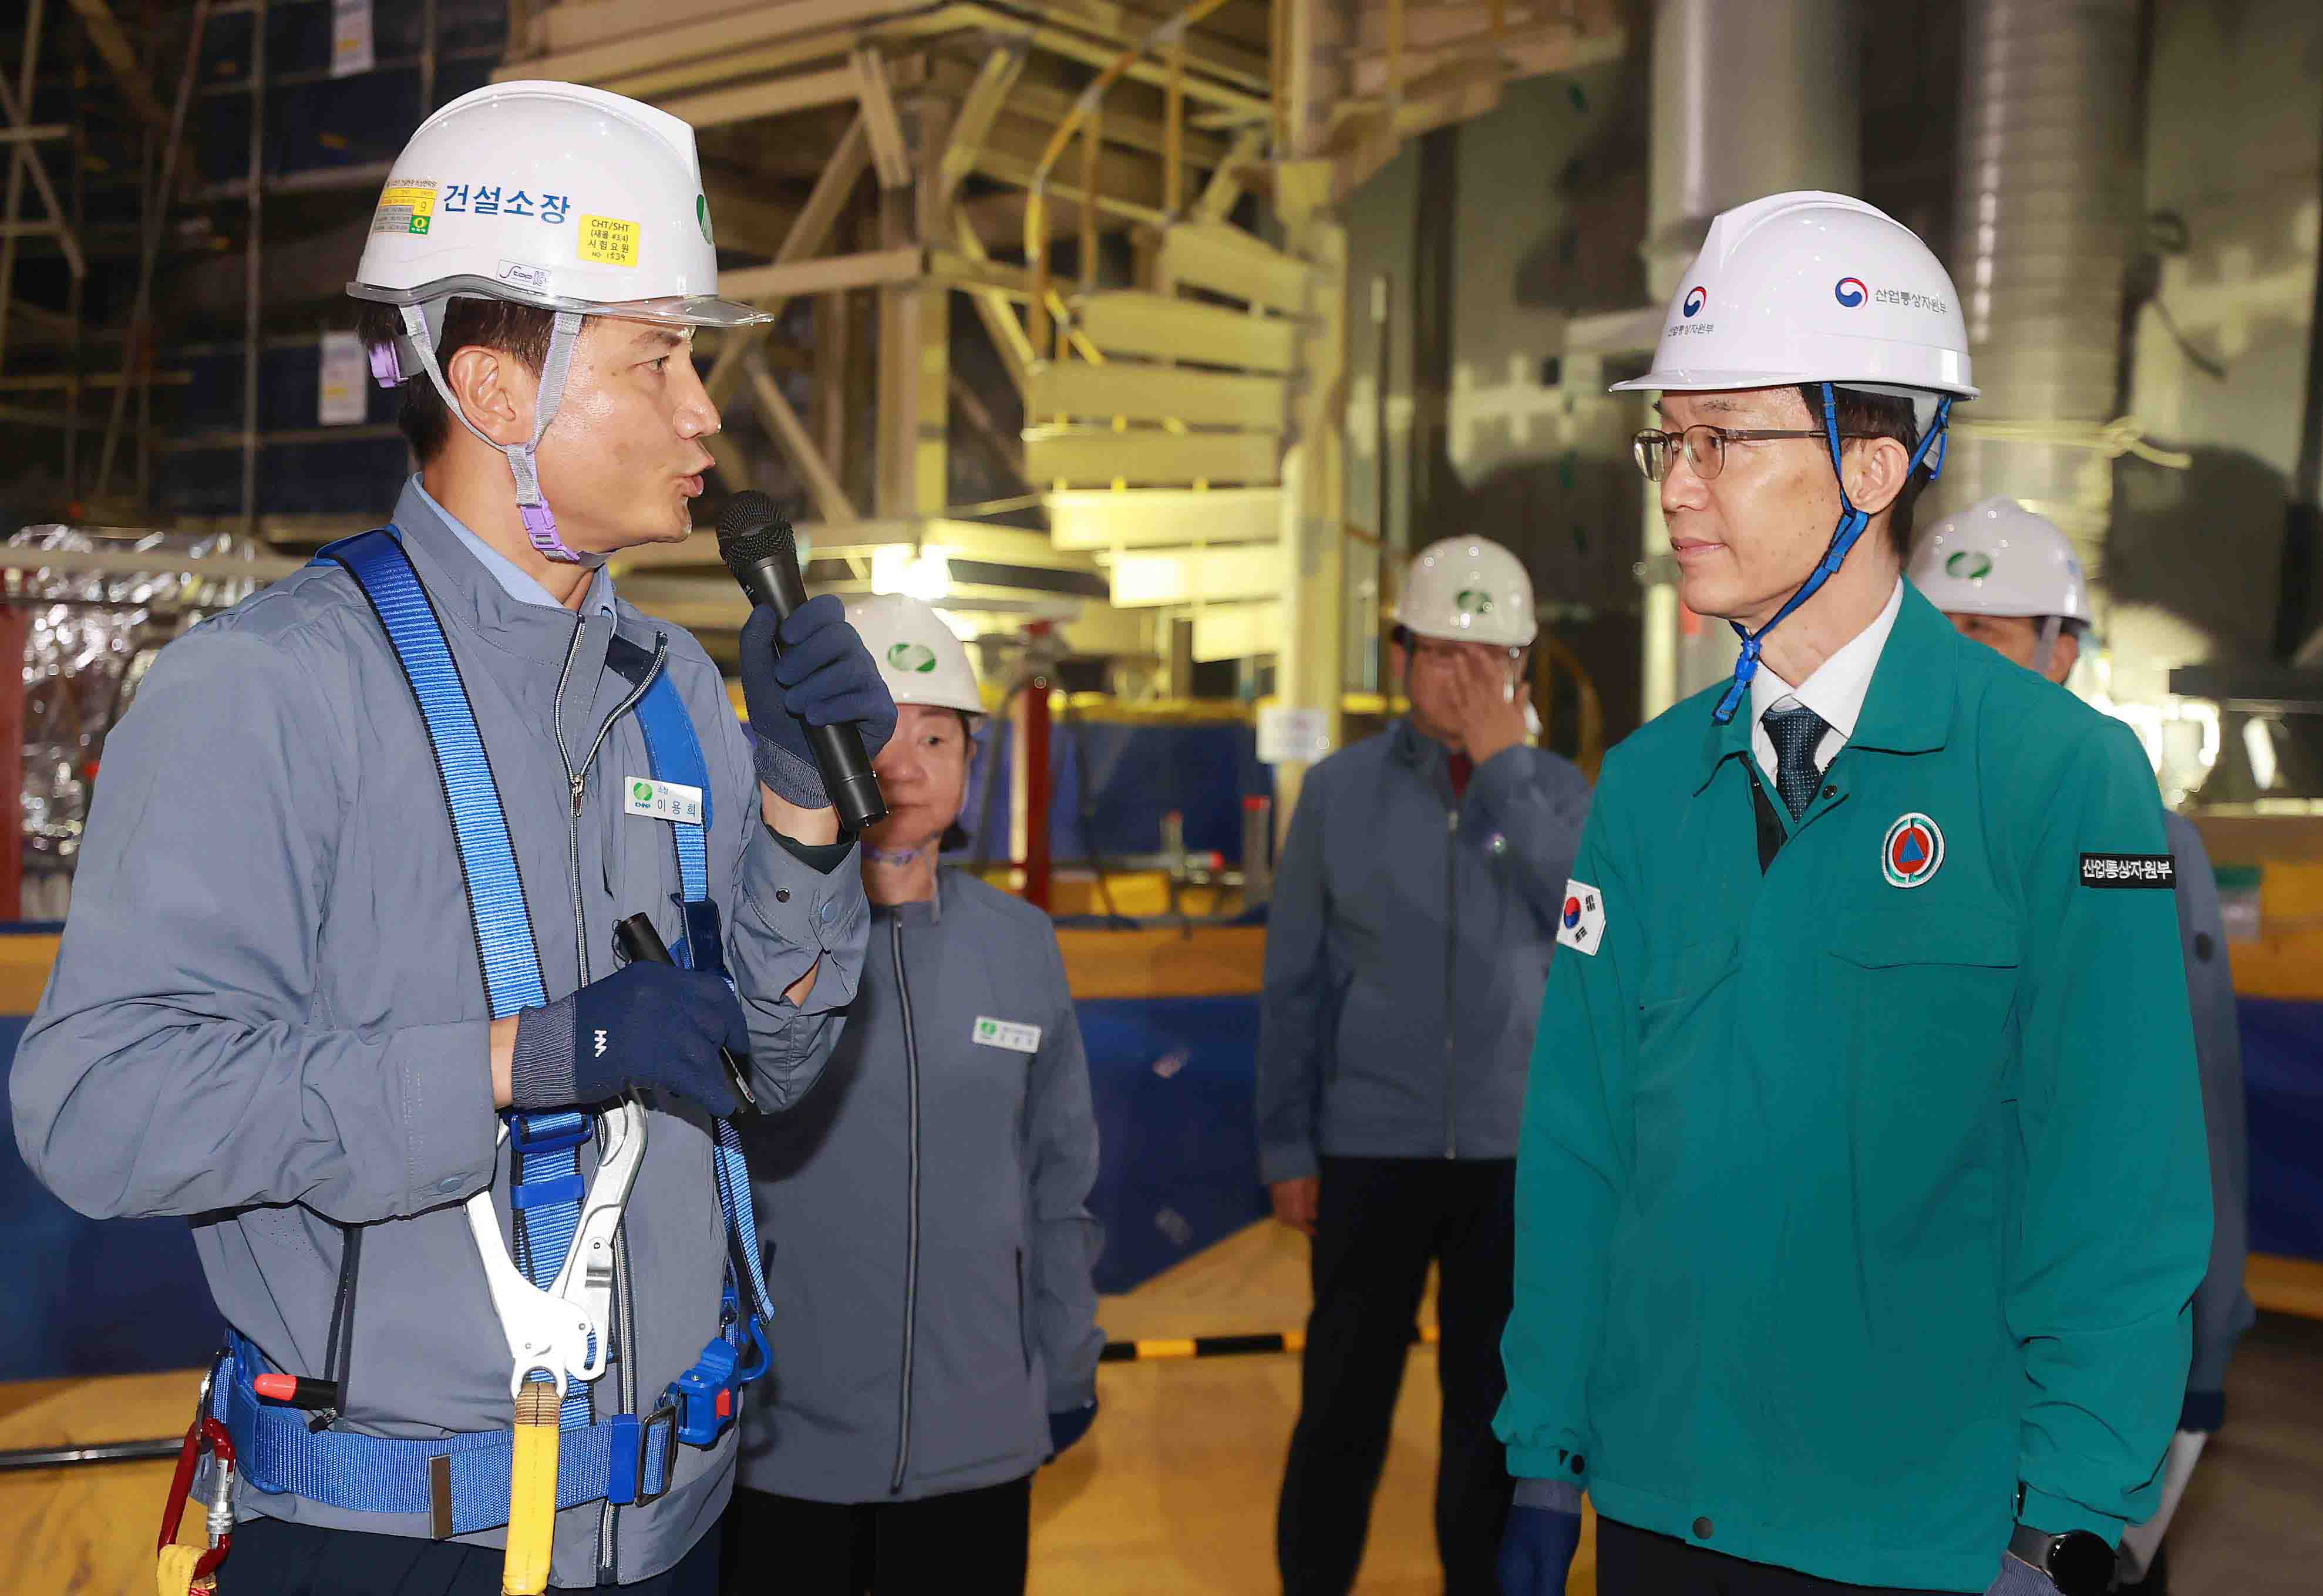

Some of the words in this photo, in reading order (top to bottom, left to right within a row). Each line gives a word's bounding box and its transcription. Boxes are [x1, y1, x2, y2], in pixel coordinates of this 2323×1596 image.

[444, 184, 572, 224] 건설소장
[591, 219, 629, 232] CHT/SHT
[588, 239, 628, 253] 시험요원
[1876, 288, 1947, 315] 산업통상자원부
[2083, 859, 2173, 879] 산업통상자원부
